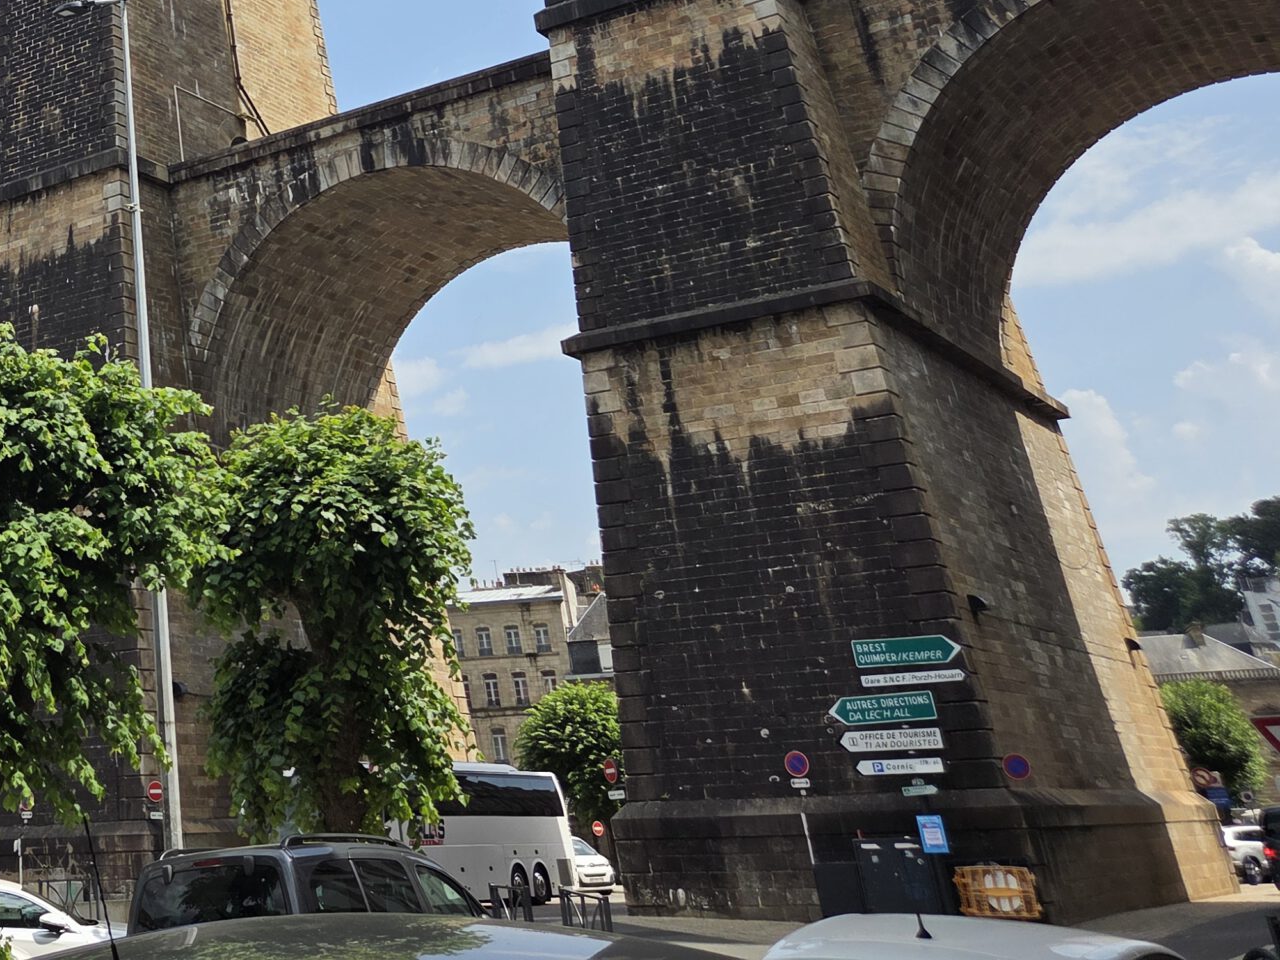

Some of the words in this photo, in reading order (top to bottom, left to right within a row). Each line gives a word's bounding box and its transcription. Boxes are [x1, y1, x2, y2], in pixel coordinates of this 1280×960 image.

[855, 643, 886, 653] BREST
[858, 650, 943, 664] QUIMPER/KEMPER
[846, 700, 878, 710] AUTRES
[880, 695, 930, 708] DIRECTIONS
[849, 711, 863, 721] DA
[893, 708, 911, 717] ALL
[859, 732, 884, 741] OFFICE
[886, 731, 896, 740] DE
[899, 729, 937, 739] TOURISME
[864, 740, 873, 749] TI
[874, 740, 888, 749] AN
[889, 738, 939, 748] DOURISTED
